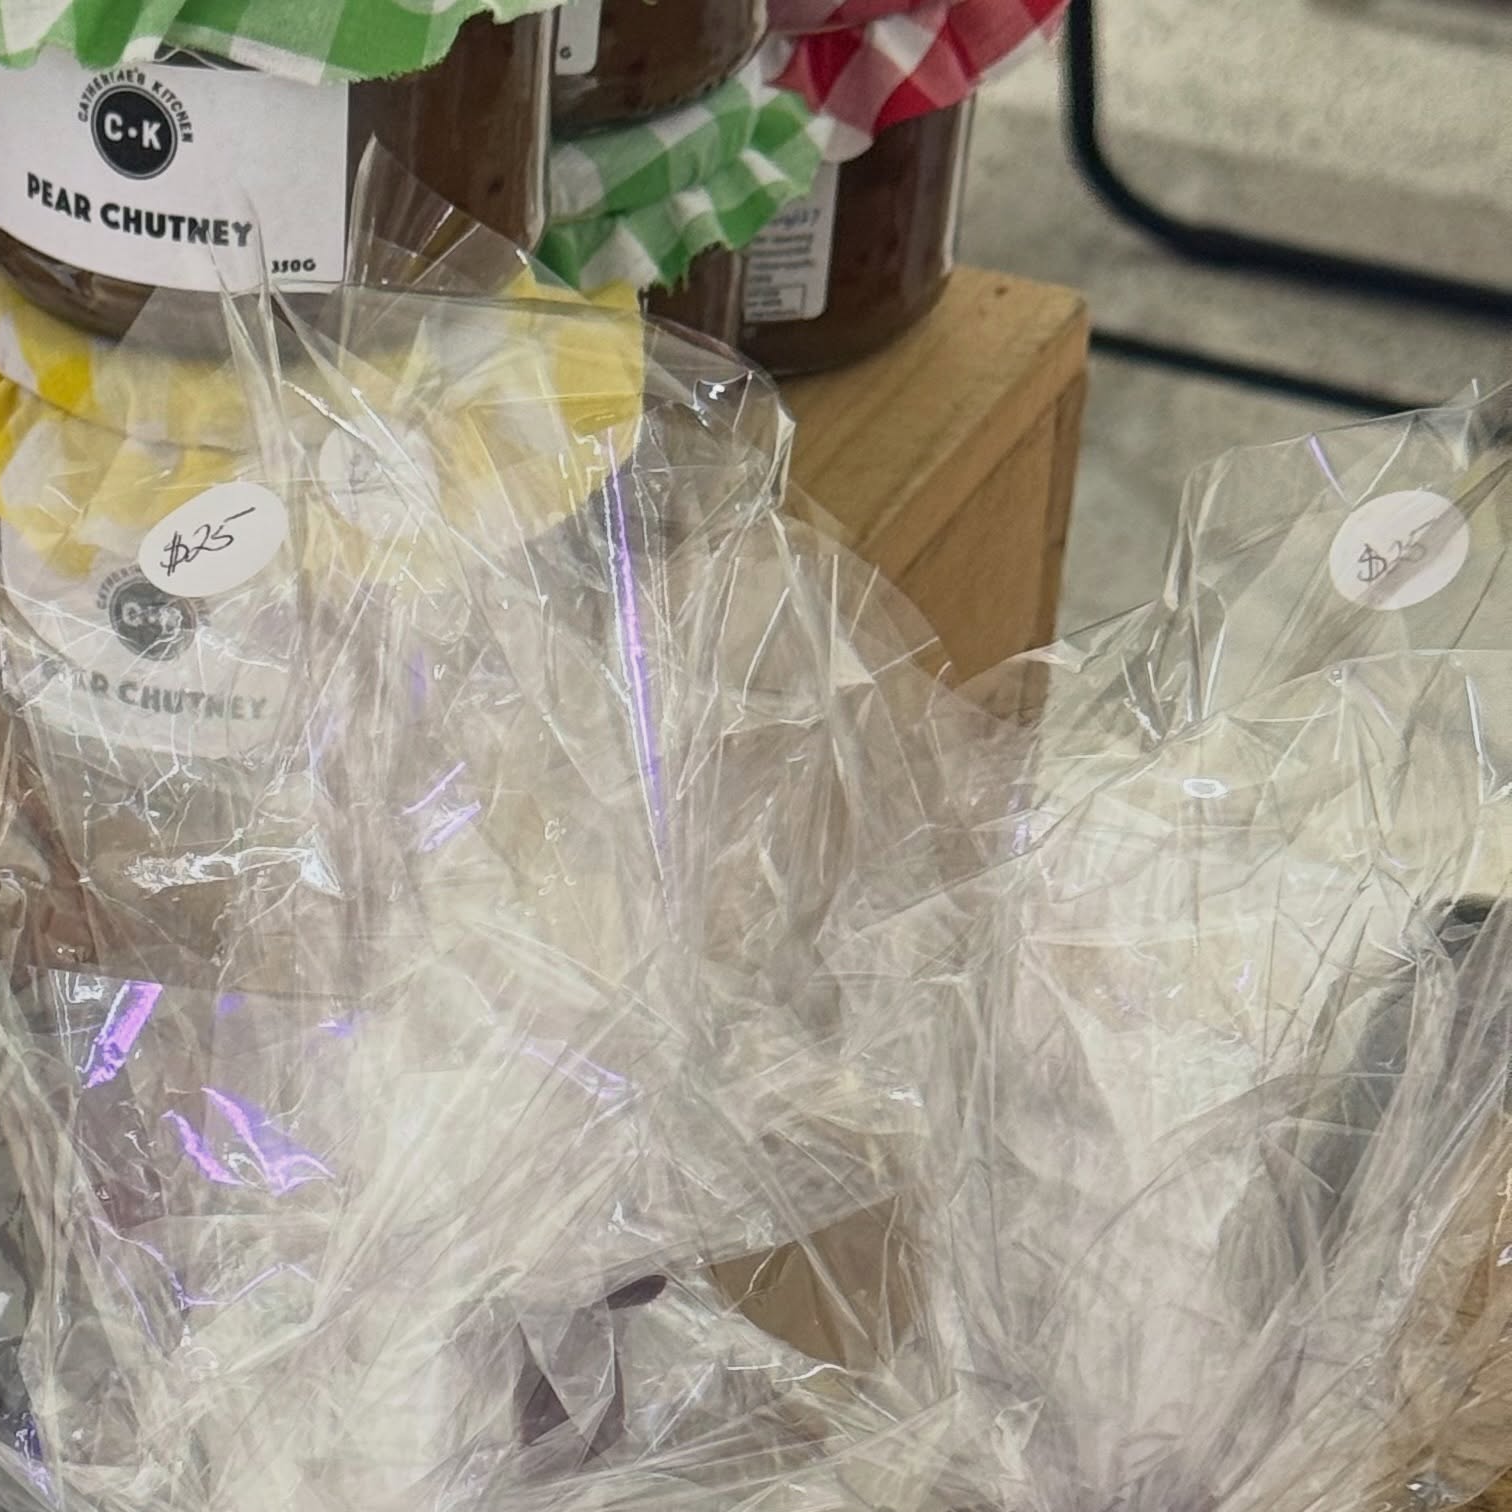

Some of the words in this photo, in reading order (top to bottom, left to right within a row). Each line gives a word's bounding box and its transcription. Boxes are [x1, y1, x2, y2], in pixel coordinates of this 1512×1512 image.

[151, 80, 194, 143] KITCHEN
[27, 172, 92, 223] PEAR
[100, 203, 253, 248] CHUTNEY
[271, 258, 316, 274] 350G
[160, 507, 256, 576] $25
[117, 681, 268, 719] CHUTNEY
